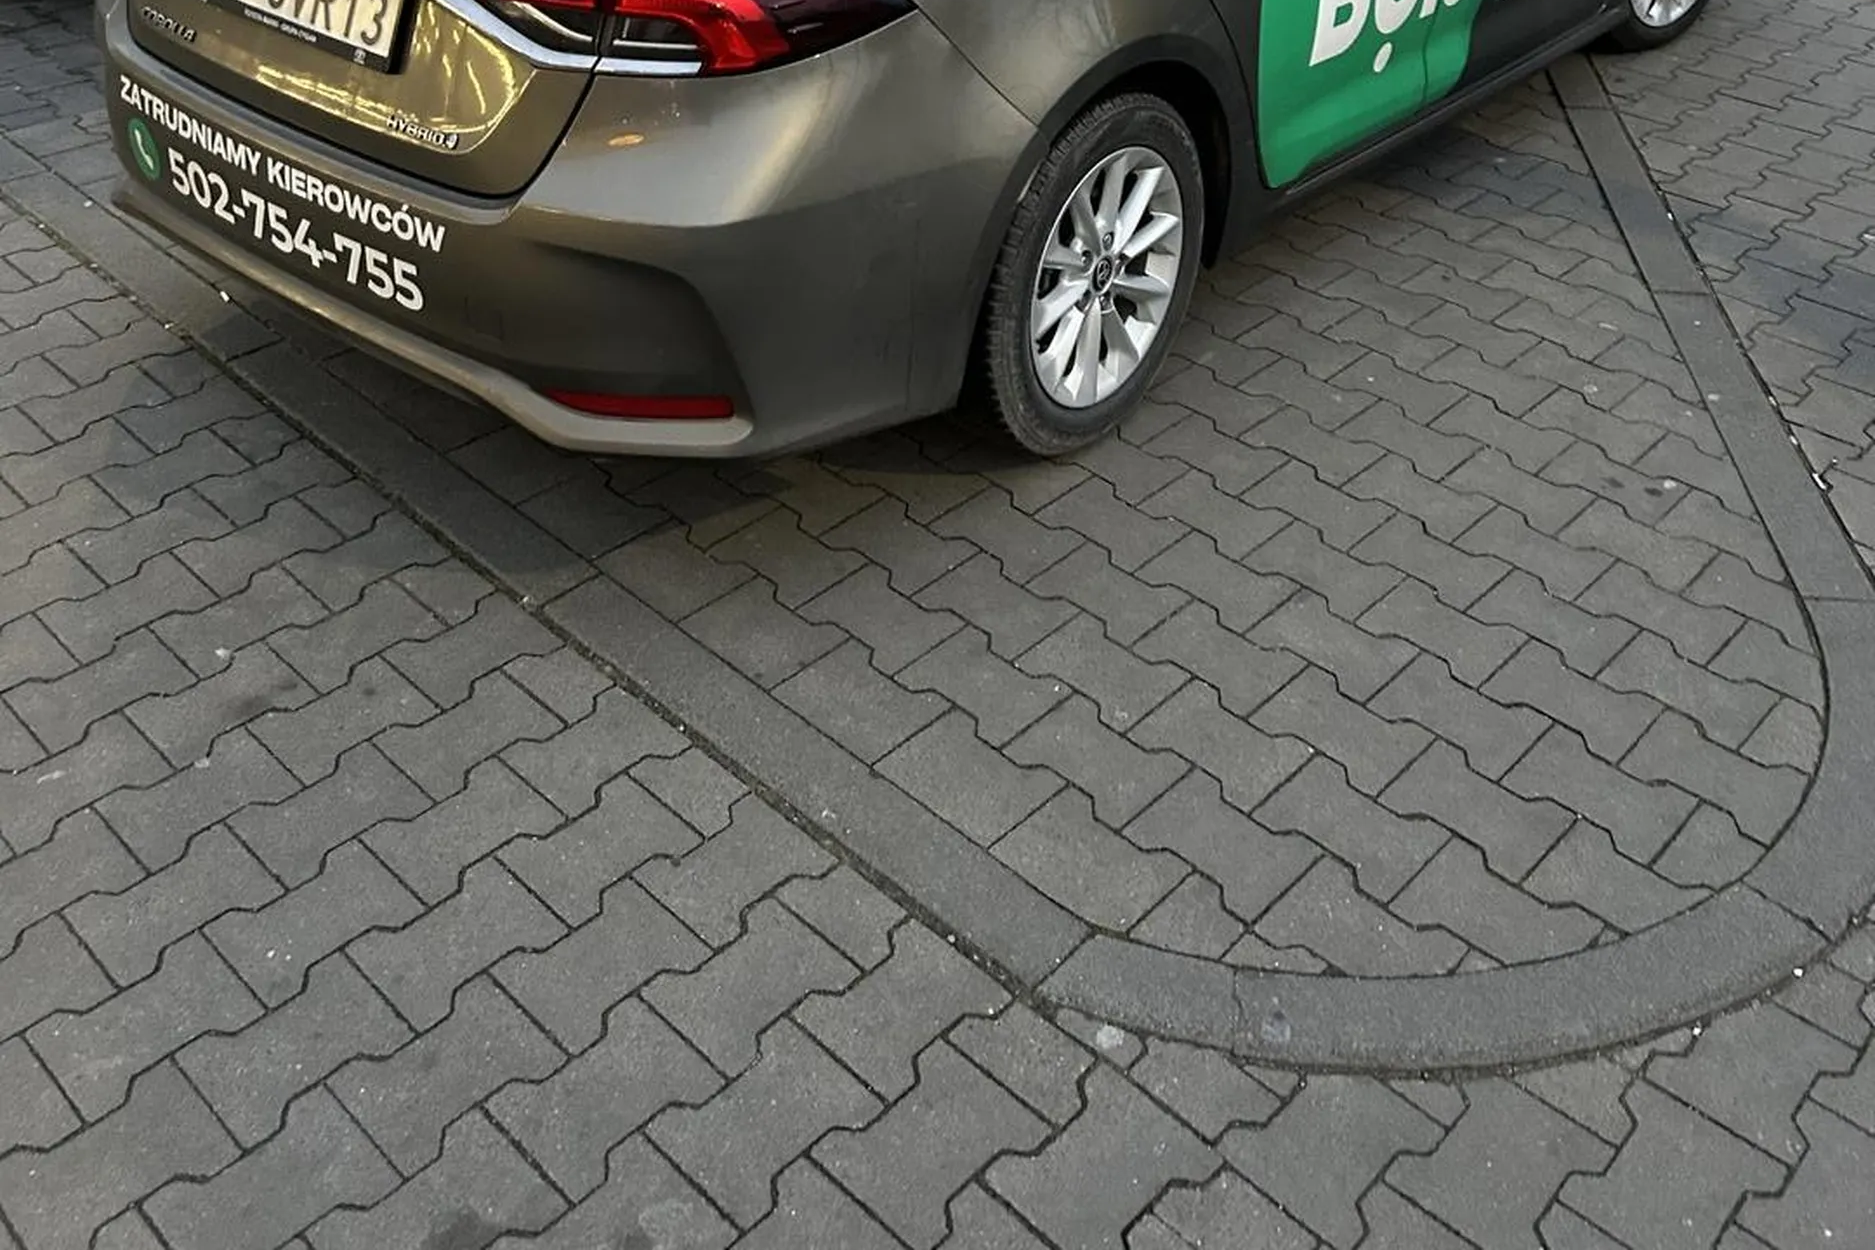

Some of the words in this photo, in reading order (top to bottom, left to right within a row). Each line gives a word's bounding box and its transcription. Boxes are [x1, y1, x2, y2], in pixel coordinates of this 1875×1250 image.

[120, 74, 261, 176] ZATRUDNIAMY
[267, 157, 446, 252] KIEROWCÓW
[386, 115, 446, 146] HYBRID
[168, 147, 424, 311] 502-754-755
